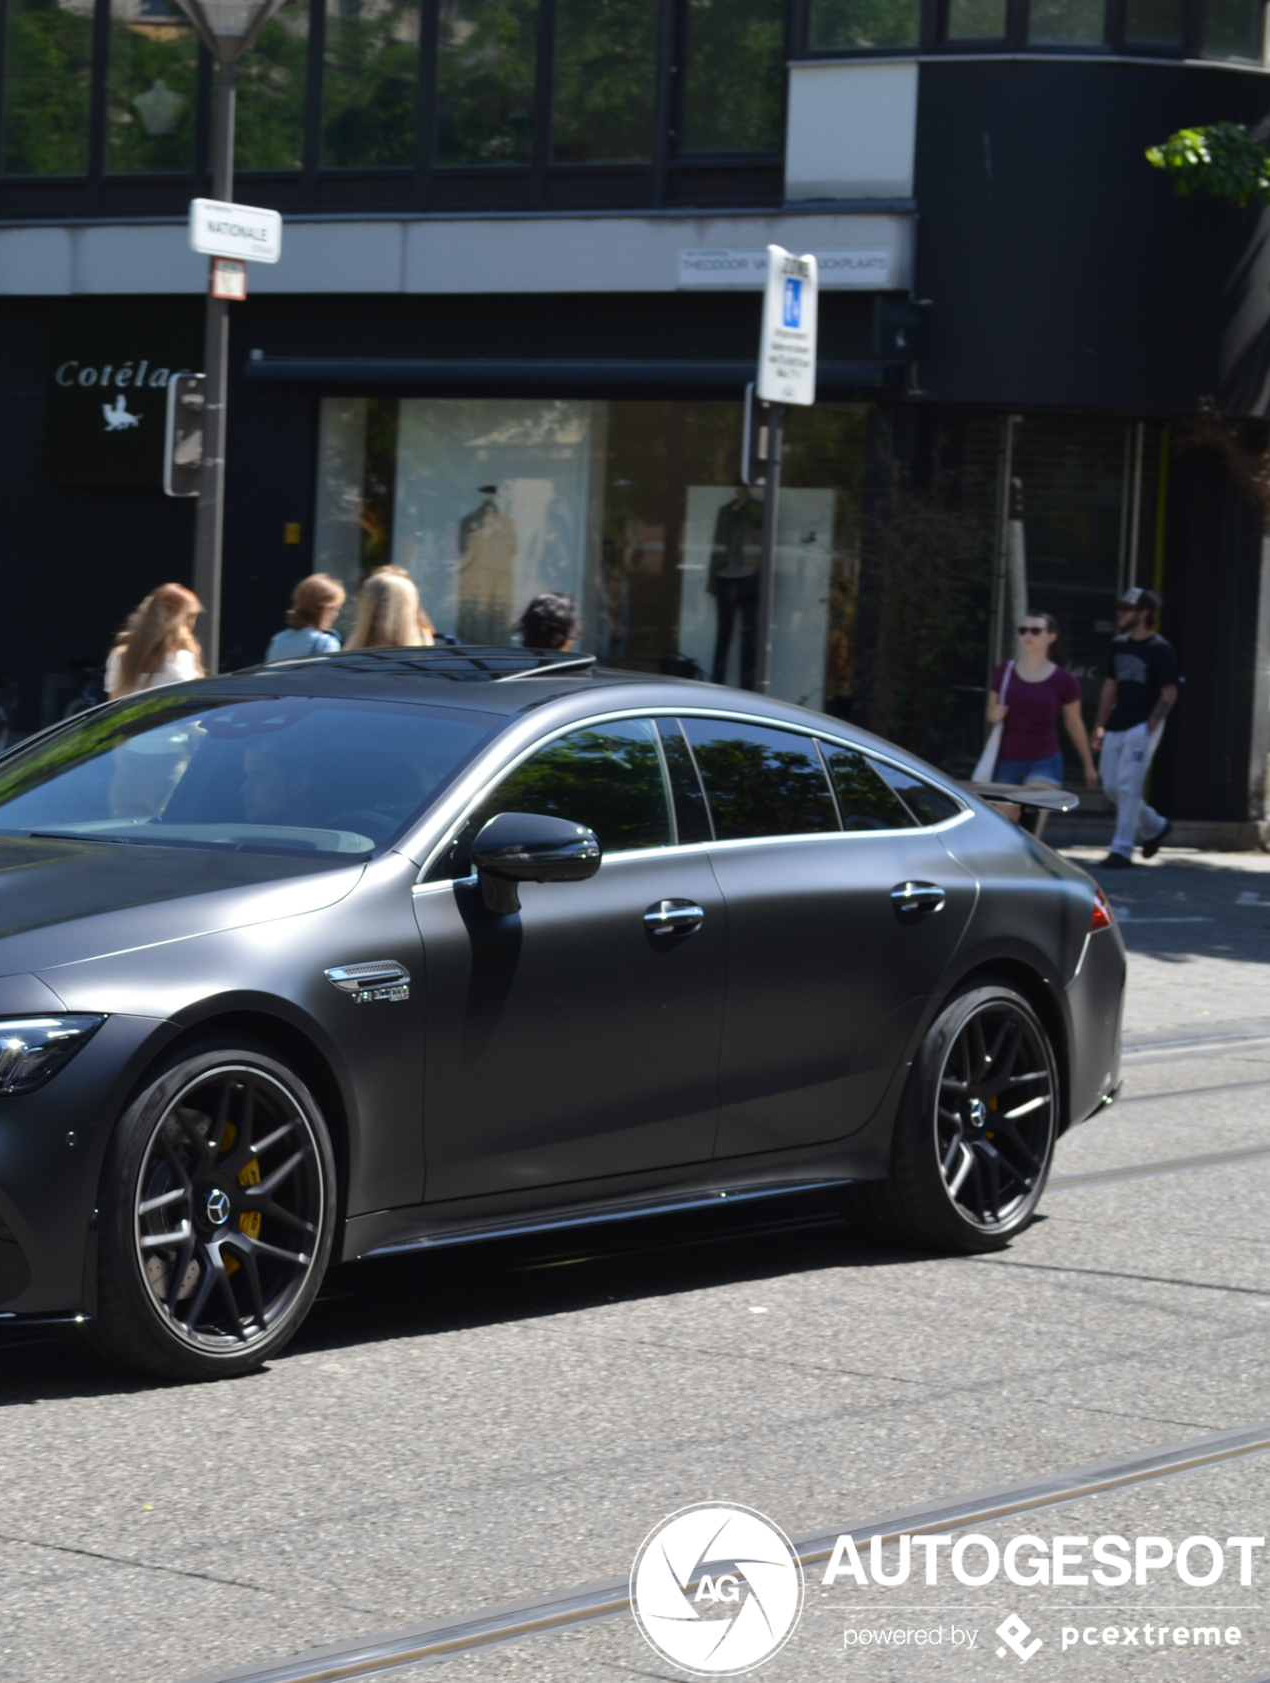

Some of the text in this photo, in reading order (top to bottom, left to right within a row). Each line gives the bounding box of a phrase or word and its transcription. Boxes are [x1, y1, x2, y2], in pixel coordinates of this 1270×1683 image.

[206, 220, 269, 244] NATIONALE
[682, 258, 748, 271] THEODOOR
[55, 359, 190, 387] Cotéla
